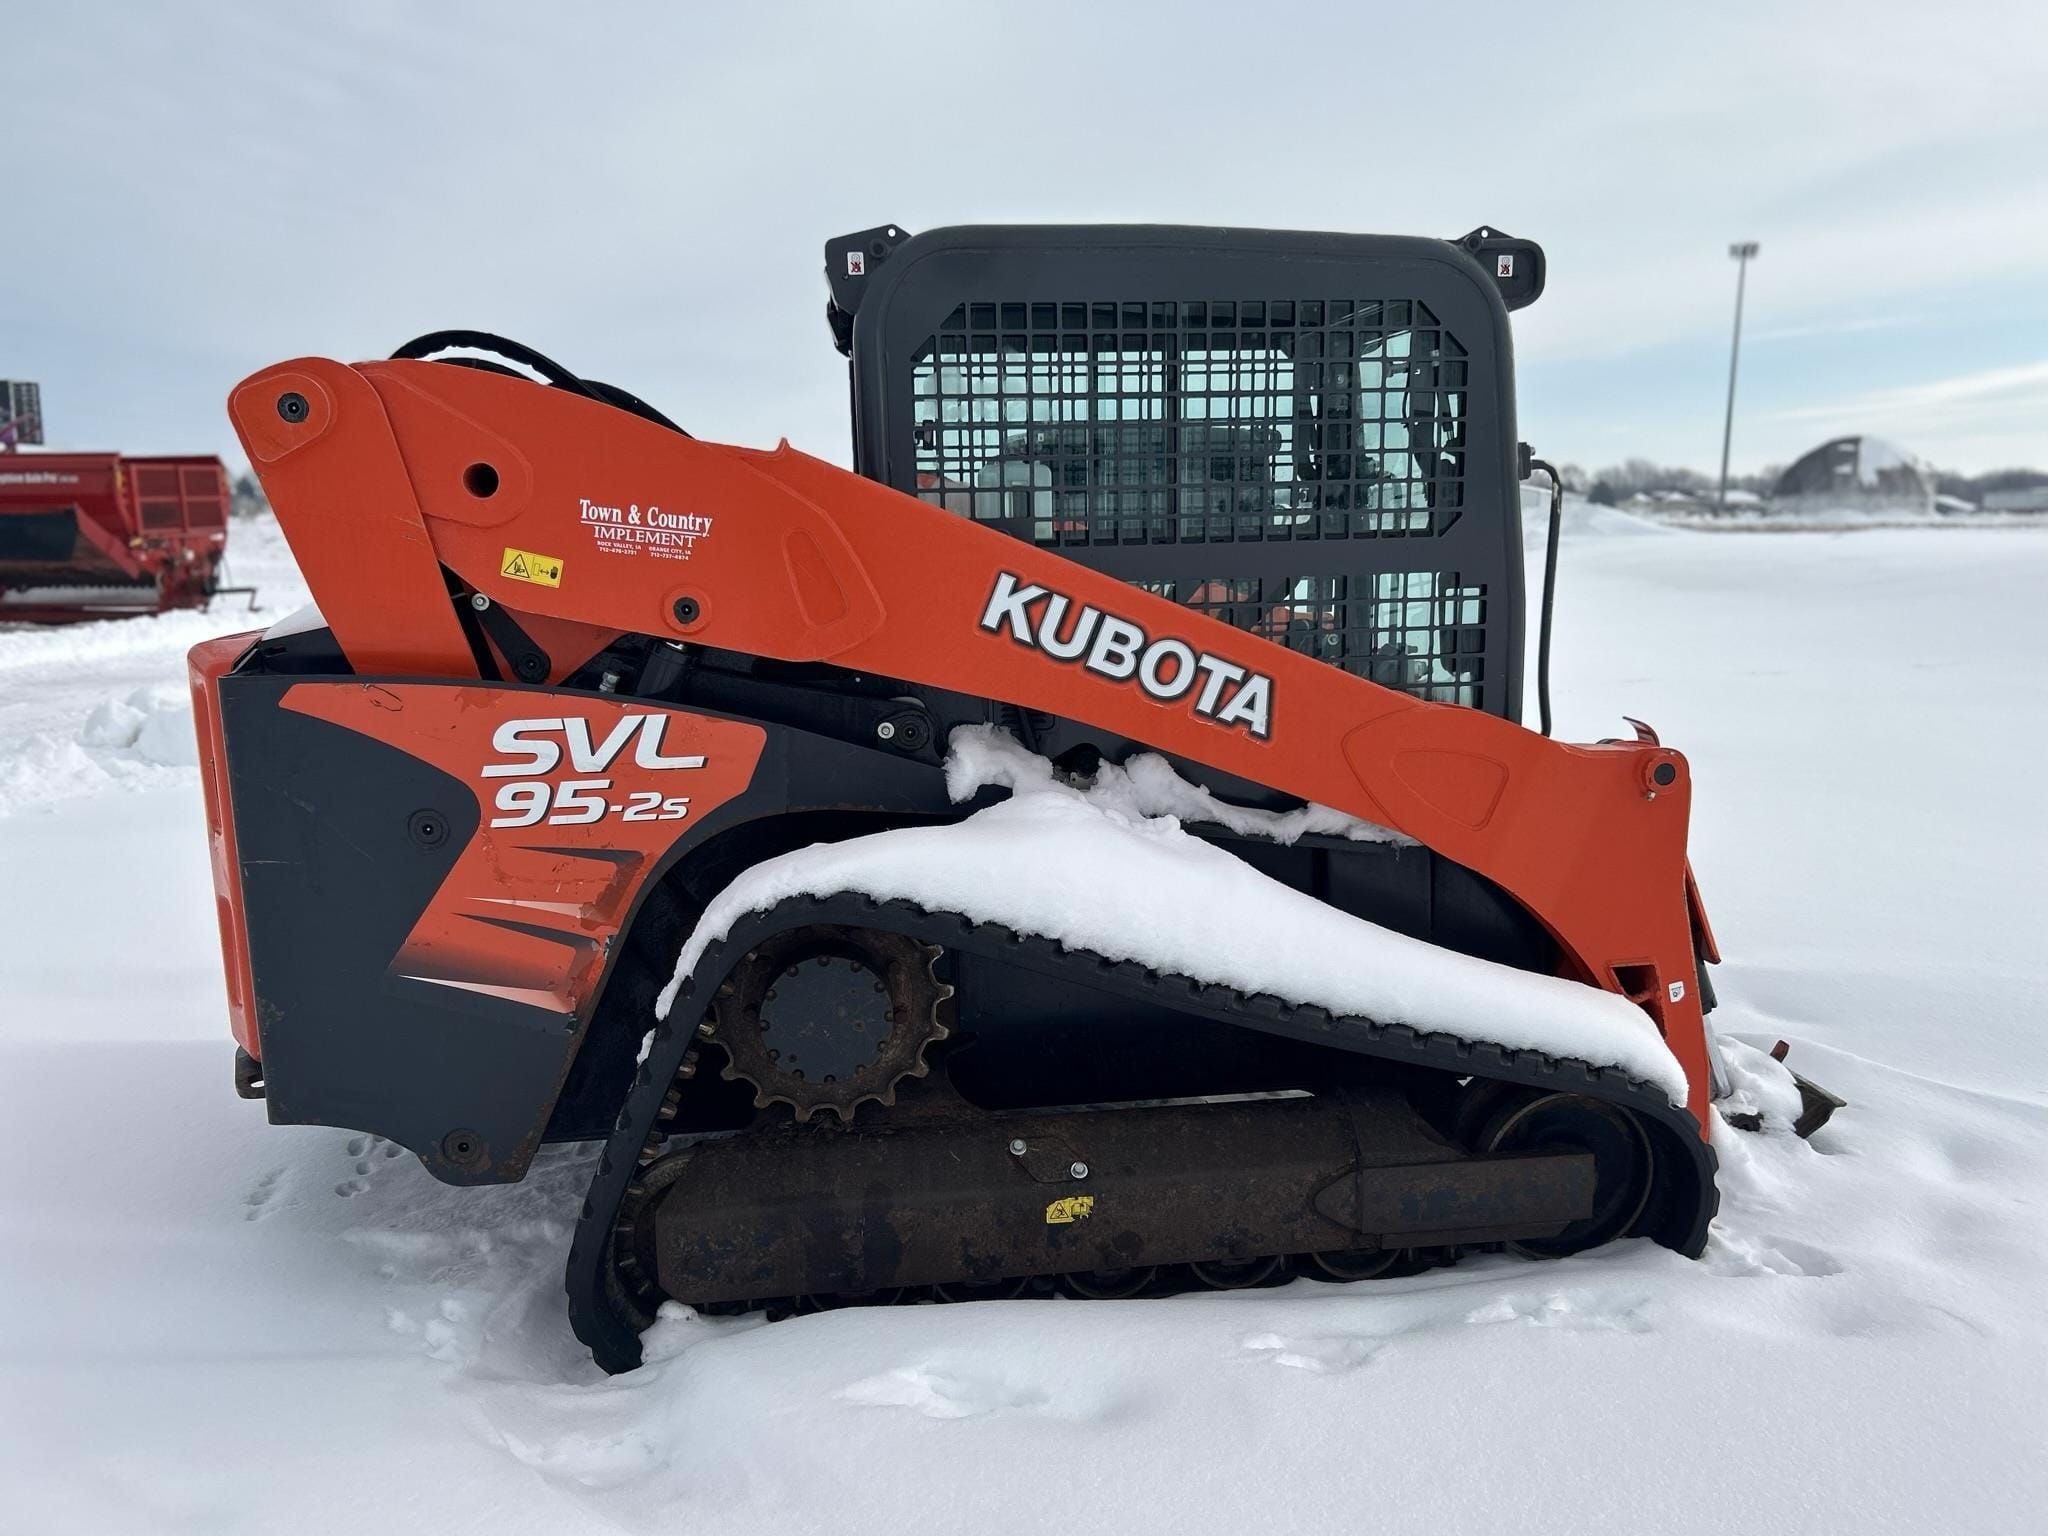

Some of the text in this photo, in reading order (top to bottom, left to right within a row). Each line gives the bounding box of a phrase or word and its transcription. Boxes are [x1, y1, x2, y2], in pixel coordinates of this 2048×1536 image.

[579, 498, 713, 537] Town & Country
[594, 526, 697, 548] IMPLEMENT
[980, 571, 1272, 738] KUBOTA
[480, 713, 707, 778] SVL
